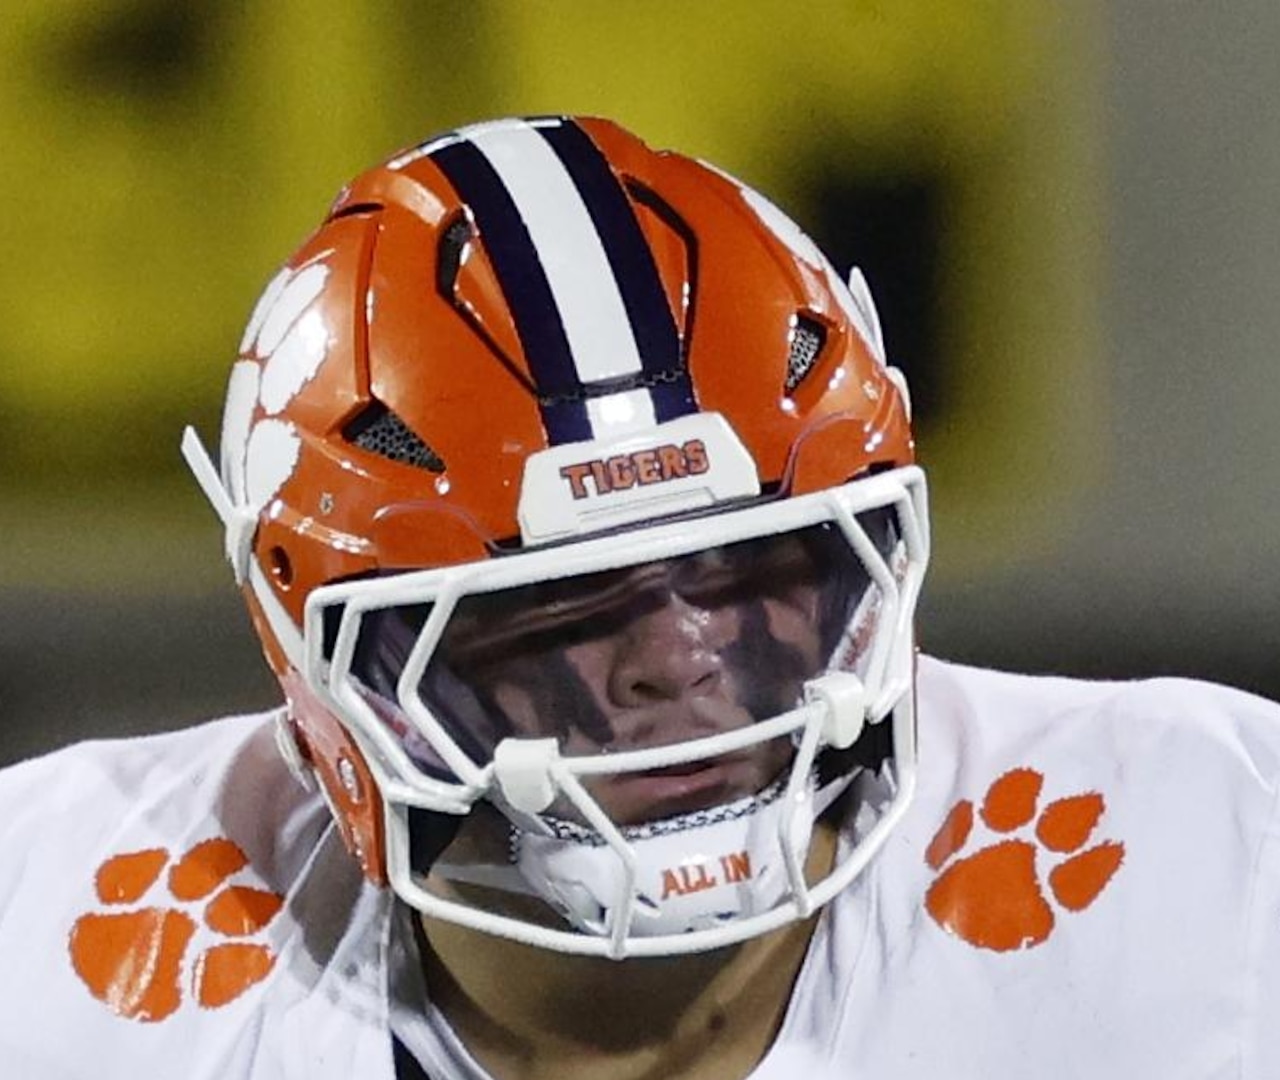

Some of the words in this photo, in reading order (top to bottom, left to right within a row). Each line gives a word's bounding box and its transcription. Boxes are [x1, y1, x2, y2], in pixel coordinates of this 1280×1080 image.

[559, 439, 710, 500] TIGERS
[661, 863, 716, 900] ALL
[719, 851, 752, 884] IN
